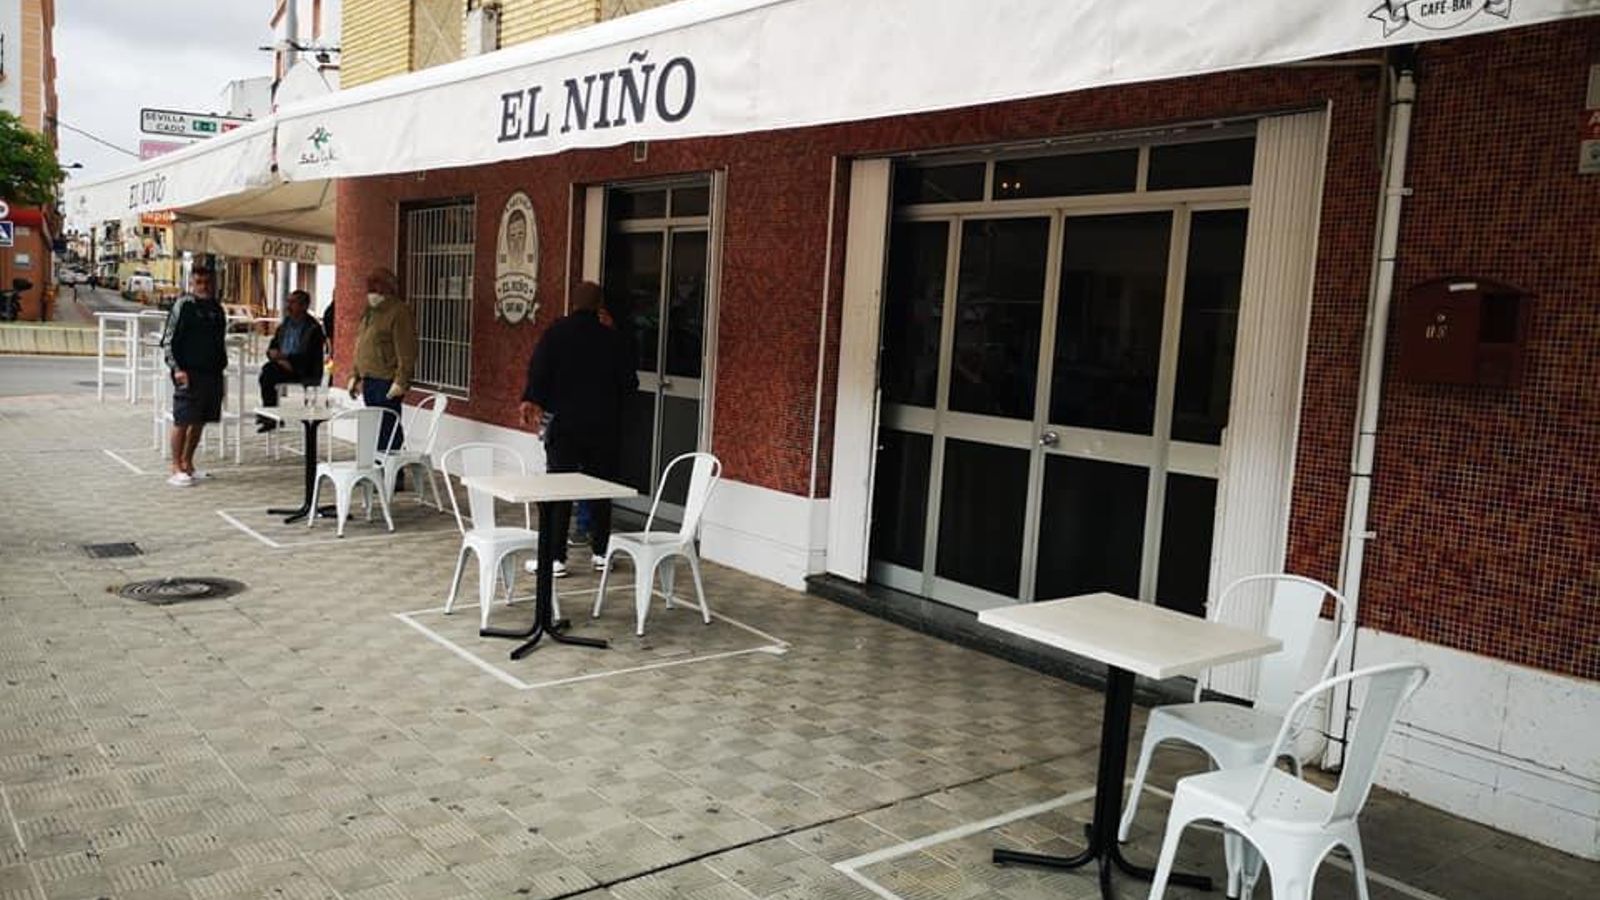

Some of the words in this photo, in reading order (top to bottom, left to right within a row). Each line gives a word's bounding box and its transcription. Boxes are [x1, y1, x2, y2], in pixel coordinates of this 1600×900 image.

[497, 86, 550, 143] EL
[560, 49, 697, 134] NIÑO
[145, 112, 186, 123] SEVILLA
[129, 184, 139, 209] EL
